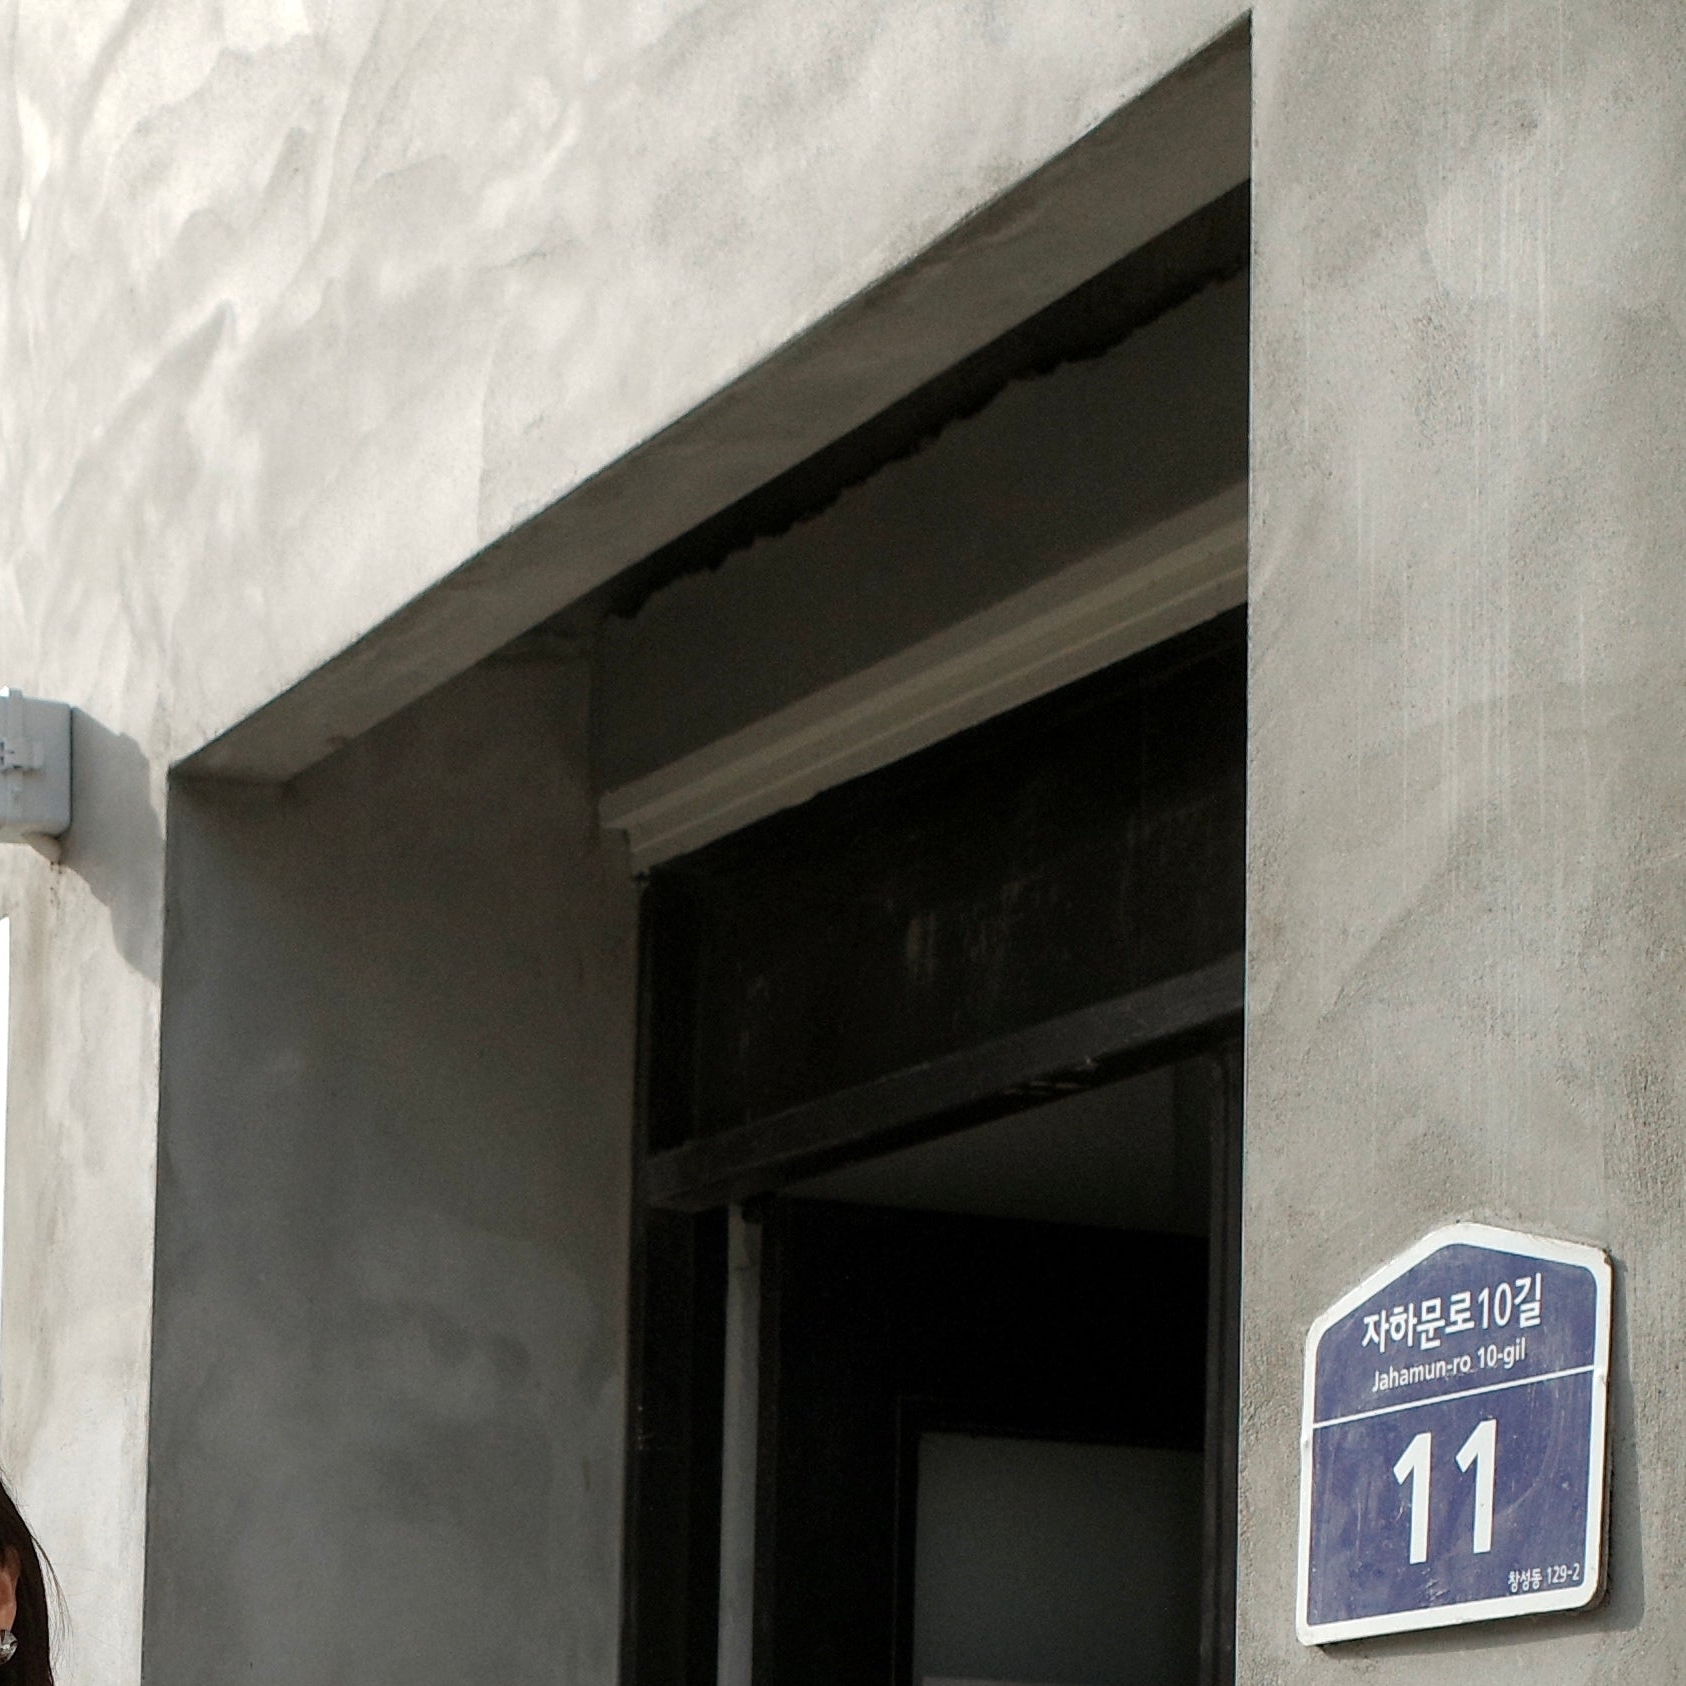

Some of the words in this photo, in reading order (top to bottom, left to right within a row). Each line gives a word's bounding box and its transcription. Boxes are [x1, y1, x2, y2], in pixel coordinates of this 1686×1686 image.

[1361, 1272, 1542, 1354] 자하문로10길
[1371, 1354, 1472, 1393] Jahamun-ro
[1477, 1336, 1527, 1371] 10-gil
[1393, 1418, 1497, 1565] 11
[1508, 1567, 1542, 1593] 창성동
[1546, 1562, 1580, 1585] 129-2
